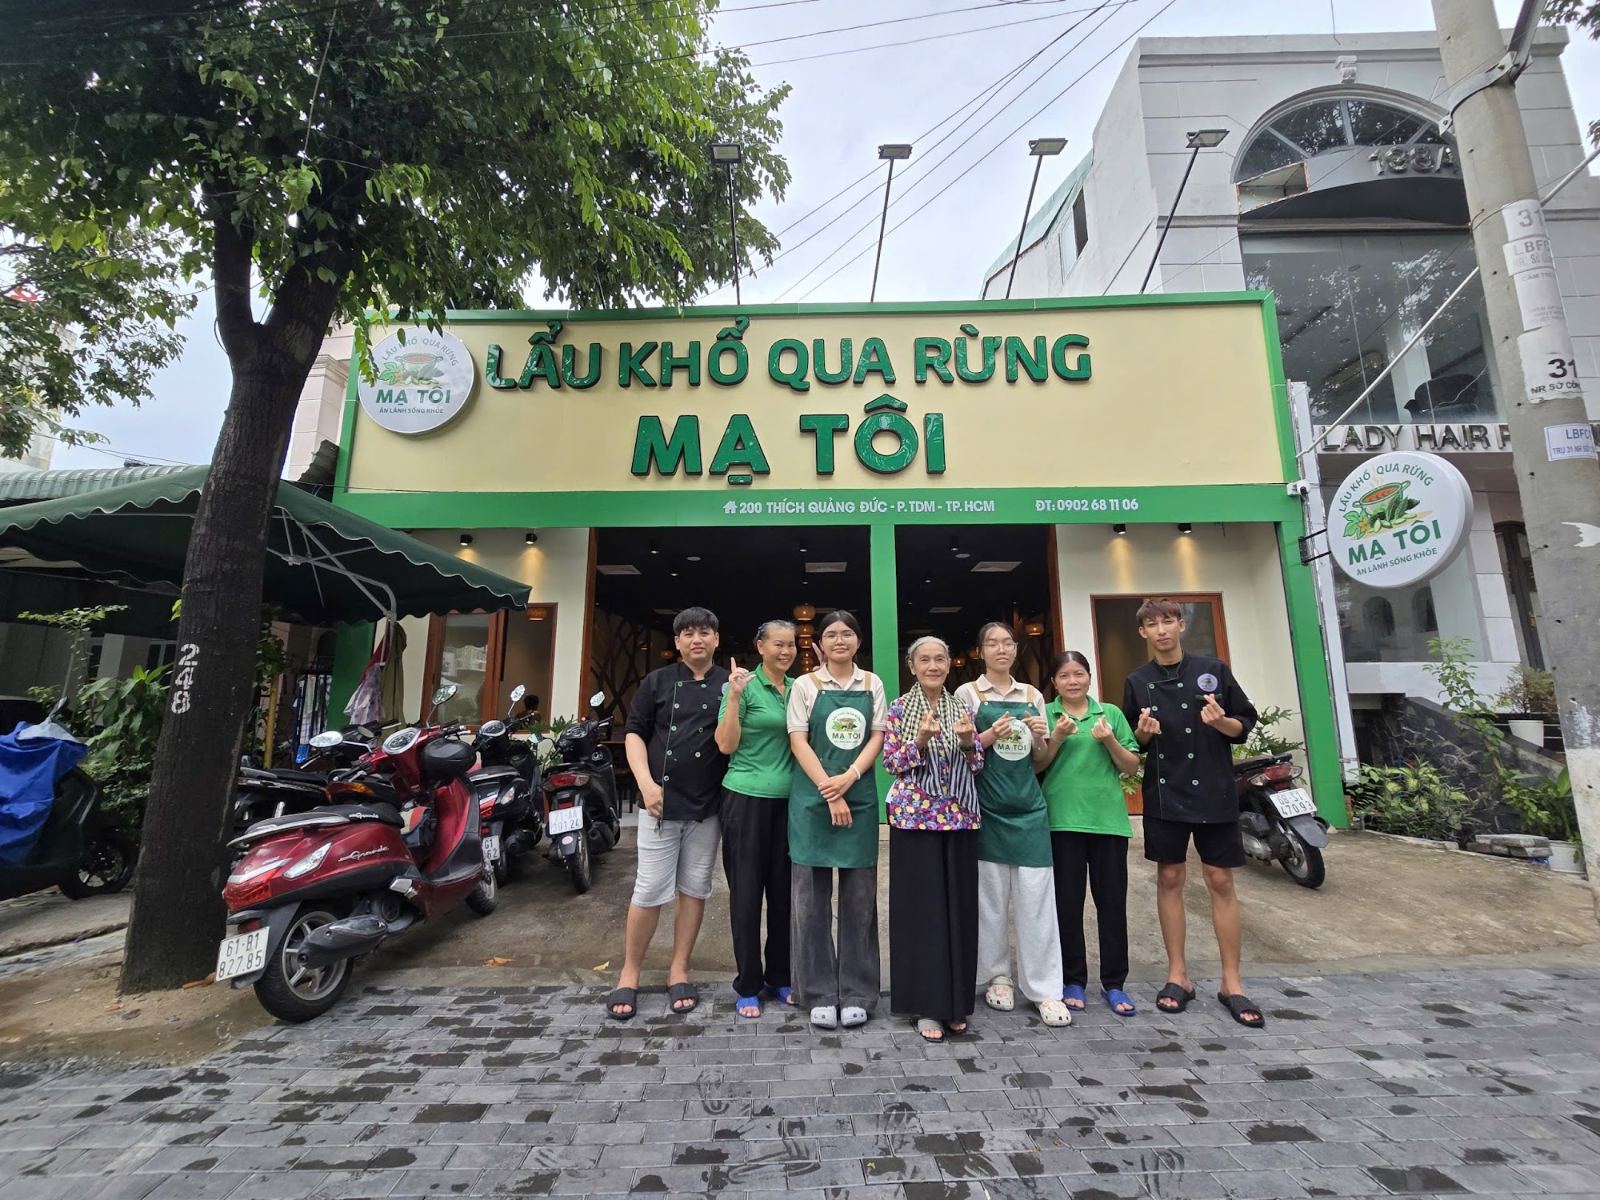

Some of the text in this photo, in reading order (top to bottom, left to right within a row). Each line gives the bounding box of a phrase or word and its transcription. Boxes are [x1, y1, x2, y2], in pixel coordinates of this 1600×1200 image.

[485, 315, 1092, 392] LẨU KHỔ QUA RỪNG
[1547, 358, 1577, 379] 31
[376, 386, 451, 406] MẠ TÔI
[631, 393, 947, 485] MẠ TÔI
[1319, 425, 1402, 450] LADY
[1414, 424, 1490, 450] HAIR
[1376, 463, 1400, 475] QUA
[739, 501, 762, 514] 200
[766, 497, 804, 513] THÍCH
[808, 497, 855, 513] QUẢNG
[859, 496, 887, 513] ĐỨC
[1091, 498, 1107, 510] 68
[1108, 498, 1119, 510] 11
[1122, 498, 1139, 510] 06
[1348, 519, 1441, 565] MẠ TÔI
[171, 643, 200, 714] 248
[218, 949, 263, 978] 827.85
